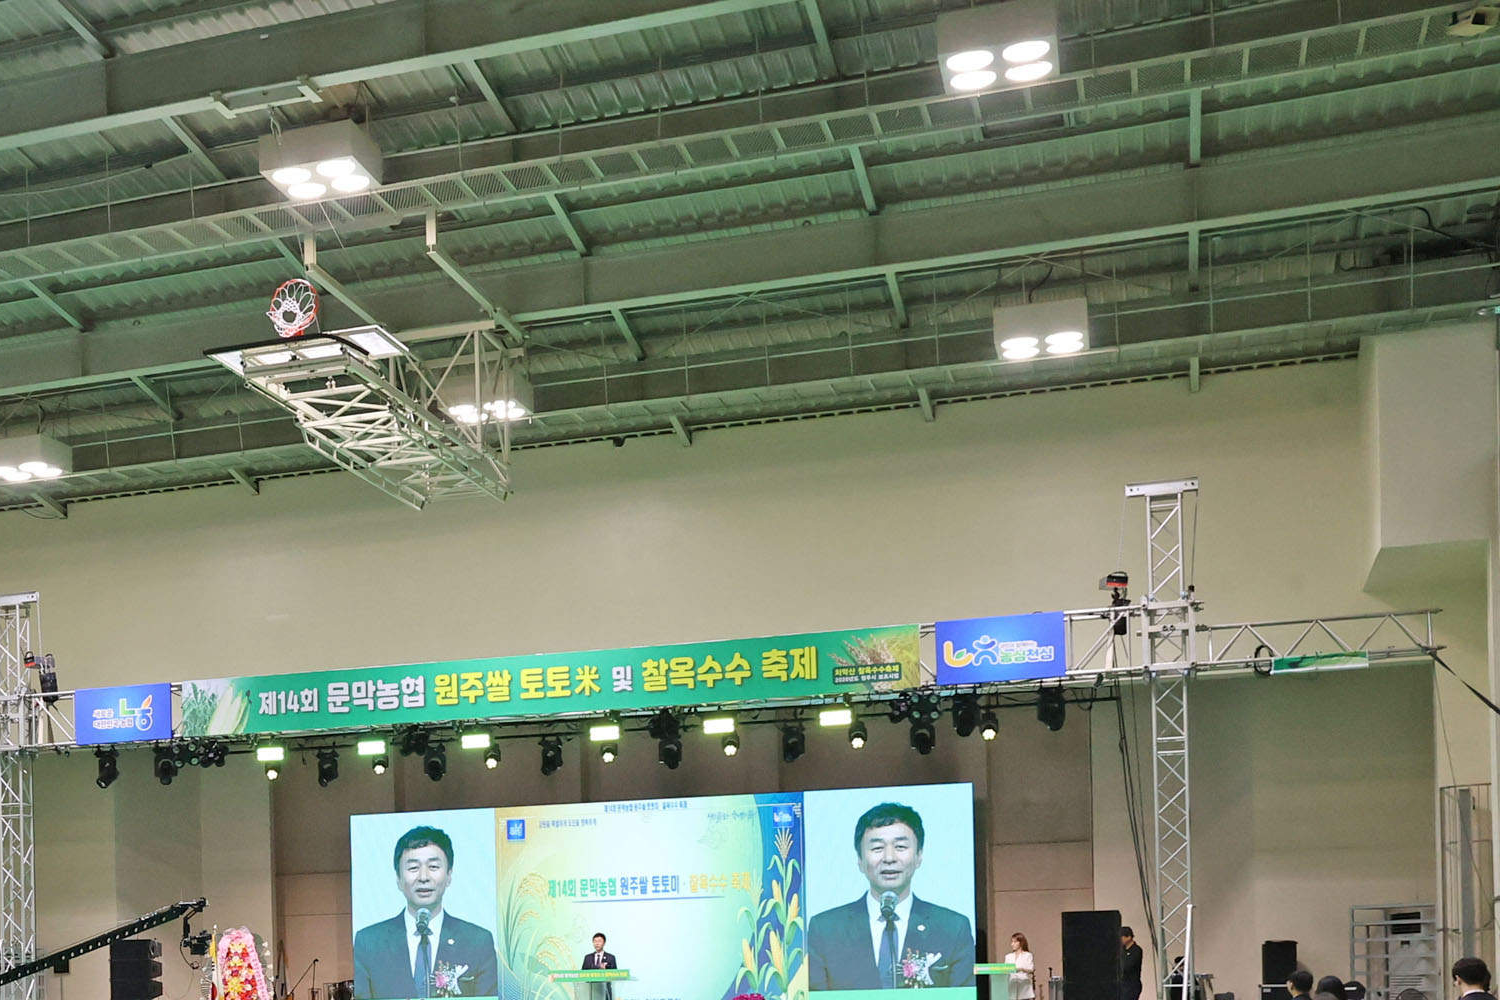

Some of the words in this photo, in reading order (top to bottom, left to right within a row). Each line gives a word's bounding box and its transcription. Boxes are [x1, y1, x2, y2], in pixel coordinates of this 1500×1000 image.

[1000, 646, 1054, 663] 농심천심
[258, 688, 319, 715] 제14회
[325, 676, 426, 714] 문막농협
[434, 668, 512, 706] 원주쌀
[520, 666, 601, 700] 토토米
[613, 665, 634, 693] 및
[641, 652, 751, 693] 찰옥수수
[760, 646, 818, 682] 축제
[548, 880, 577, 898] 제14회
[580, 878, 617, 897] 문막농협
[620, 876, 648, 896] 원주쌀
[652, 874, 680, 895] 토토미
